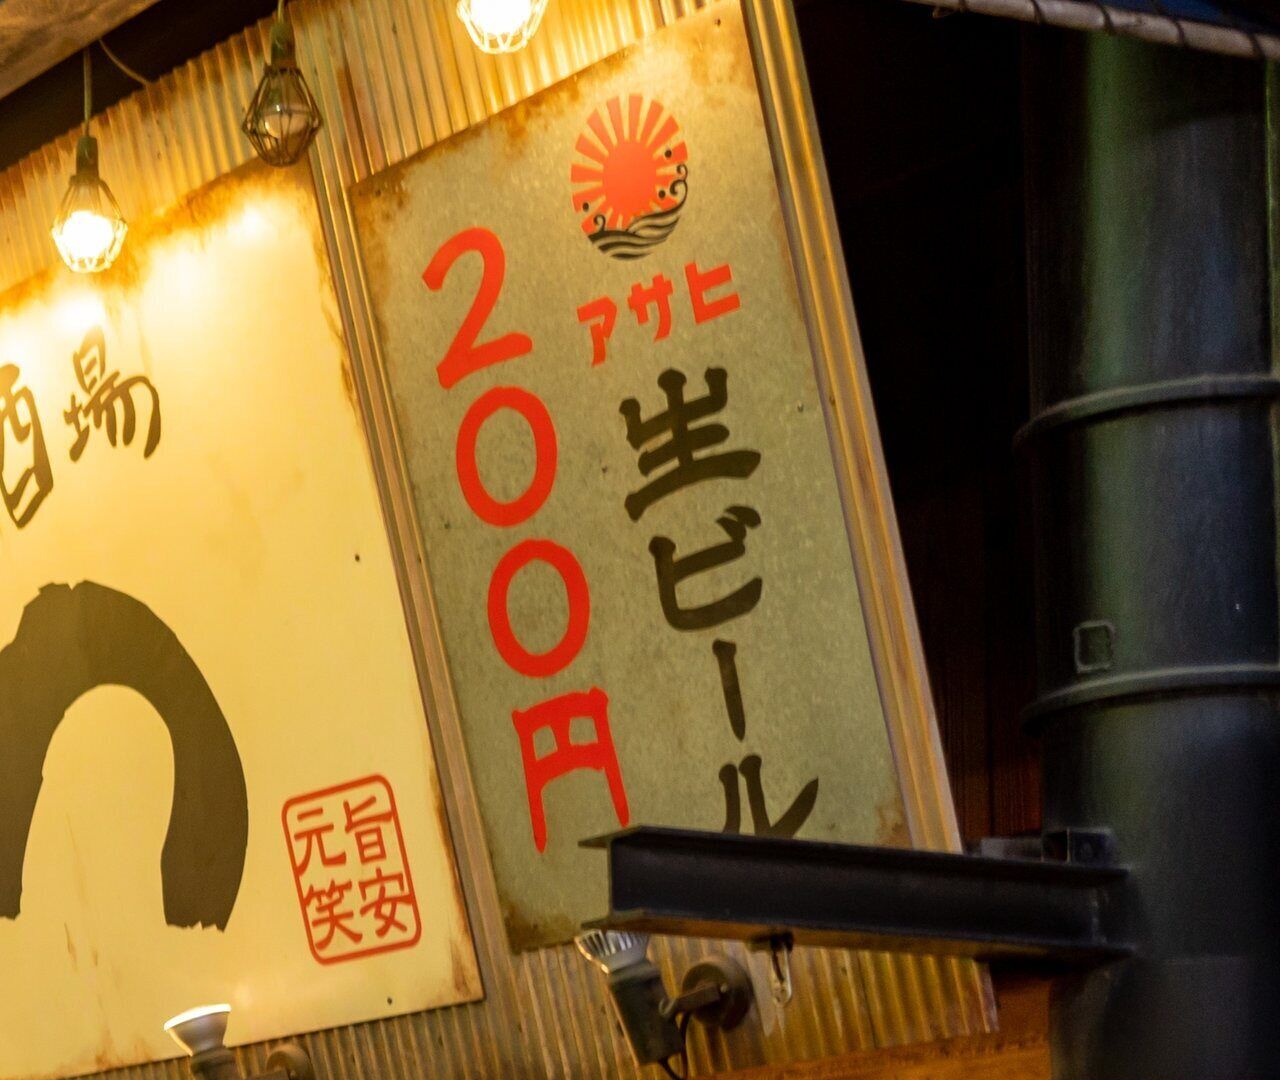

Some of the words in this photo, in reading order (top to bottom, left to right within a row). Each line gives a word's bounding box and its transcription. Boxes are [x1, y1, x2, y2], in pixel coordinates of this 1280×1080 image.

[422, 226, 630, 853] 200円
[577, 262, 741, 368] アサヒ
[618, 366, 819, 840] 生ビール
